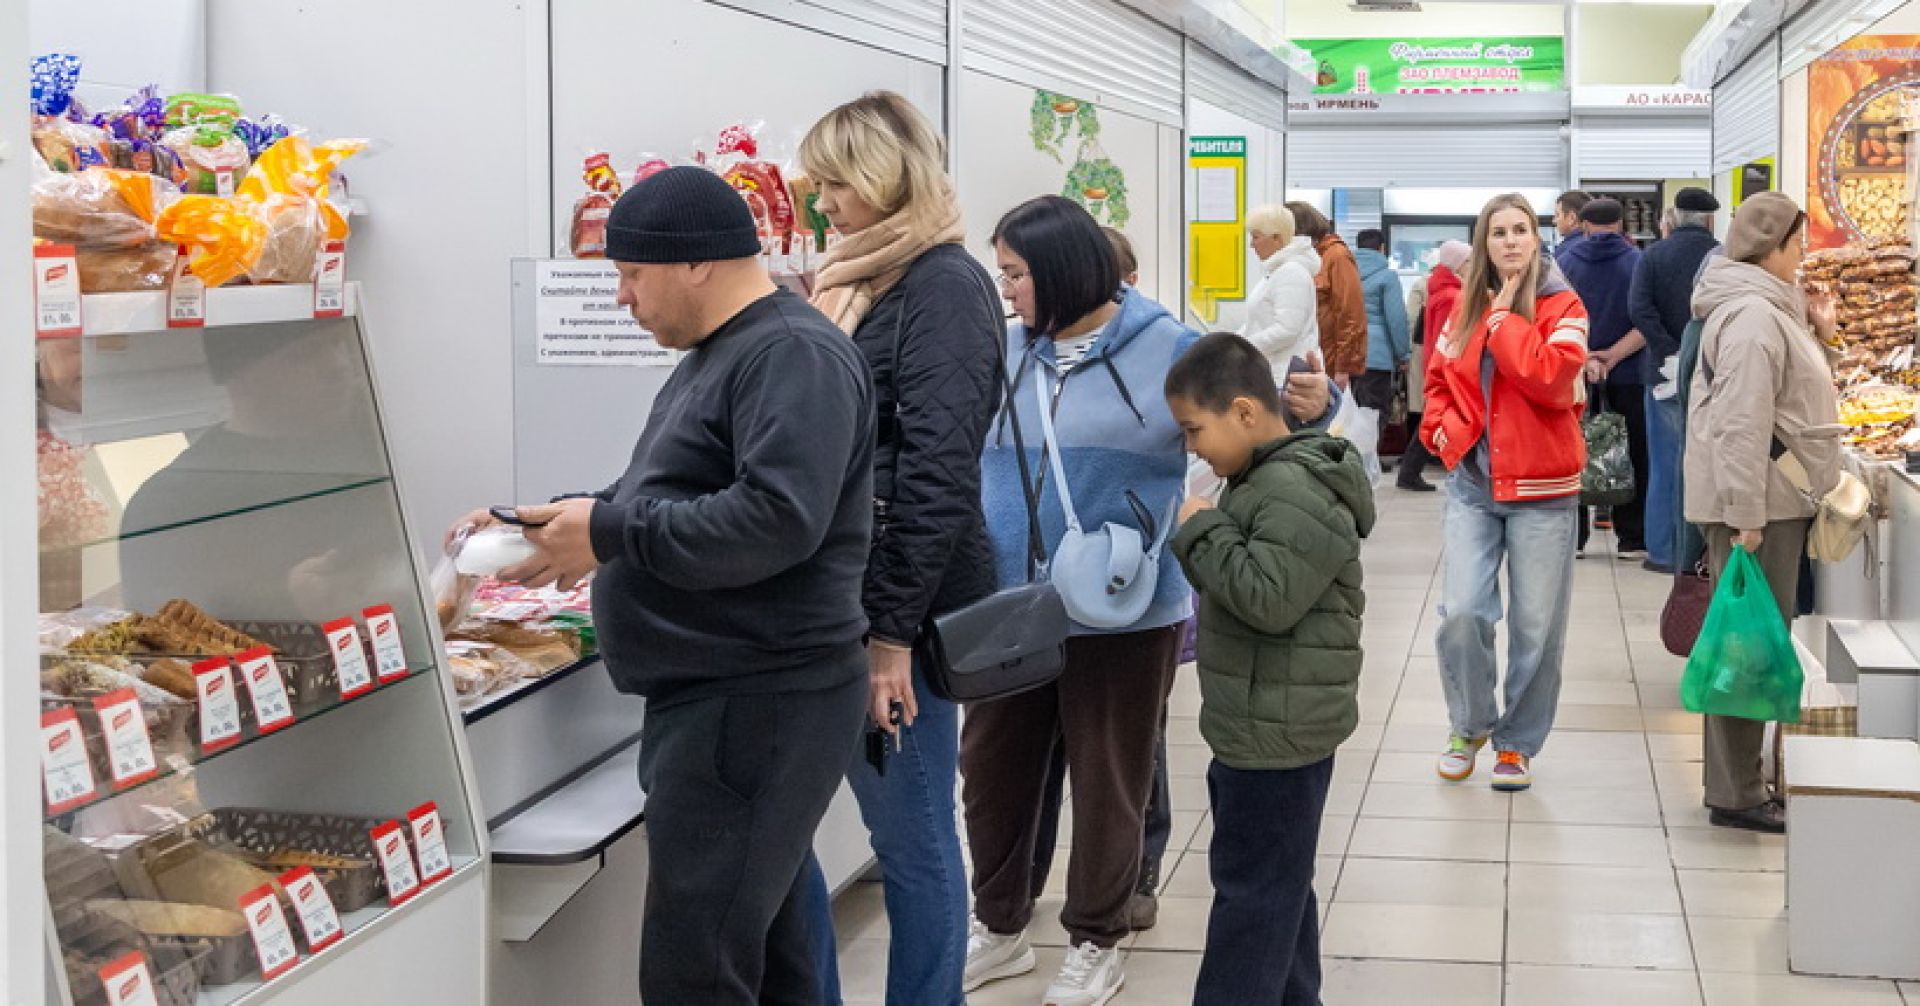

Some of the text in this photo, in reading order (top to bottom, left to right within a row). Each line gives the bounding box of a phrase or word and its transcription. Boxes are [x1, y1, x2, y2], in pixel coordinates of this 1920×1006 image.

[1401, 67, 1520, 79] ЗАО ПЛЕМЗАВОД
[1626, 93, 1649, 104] АО
